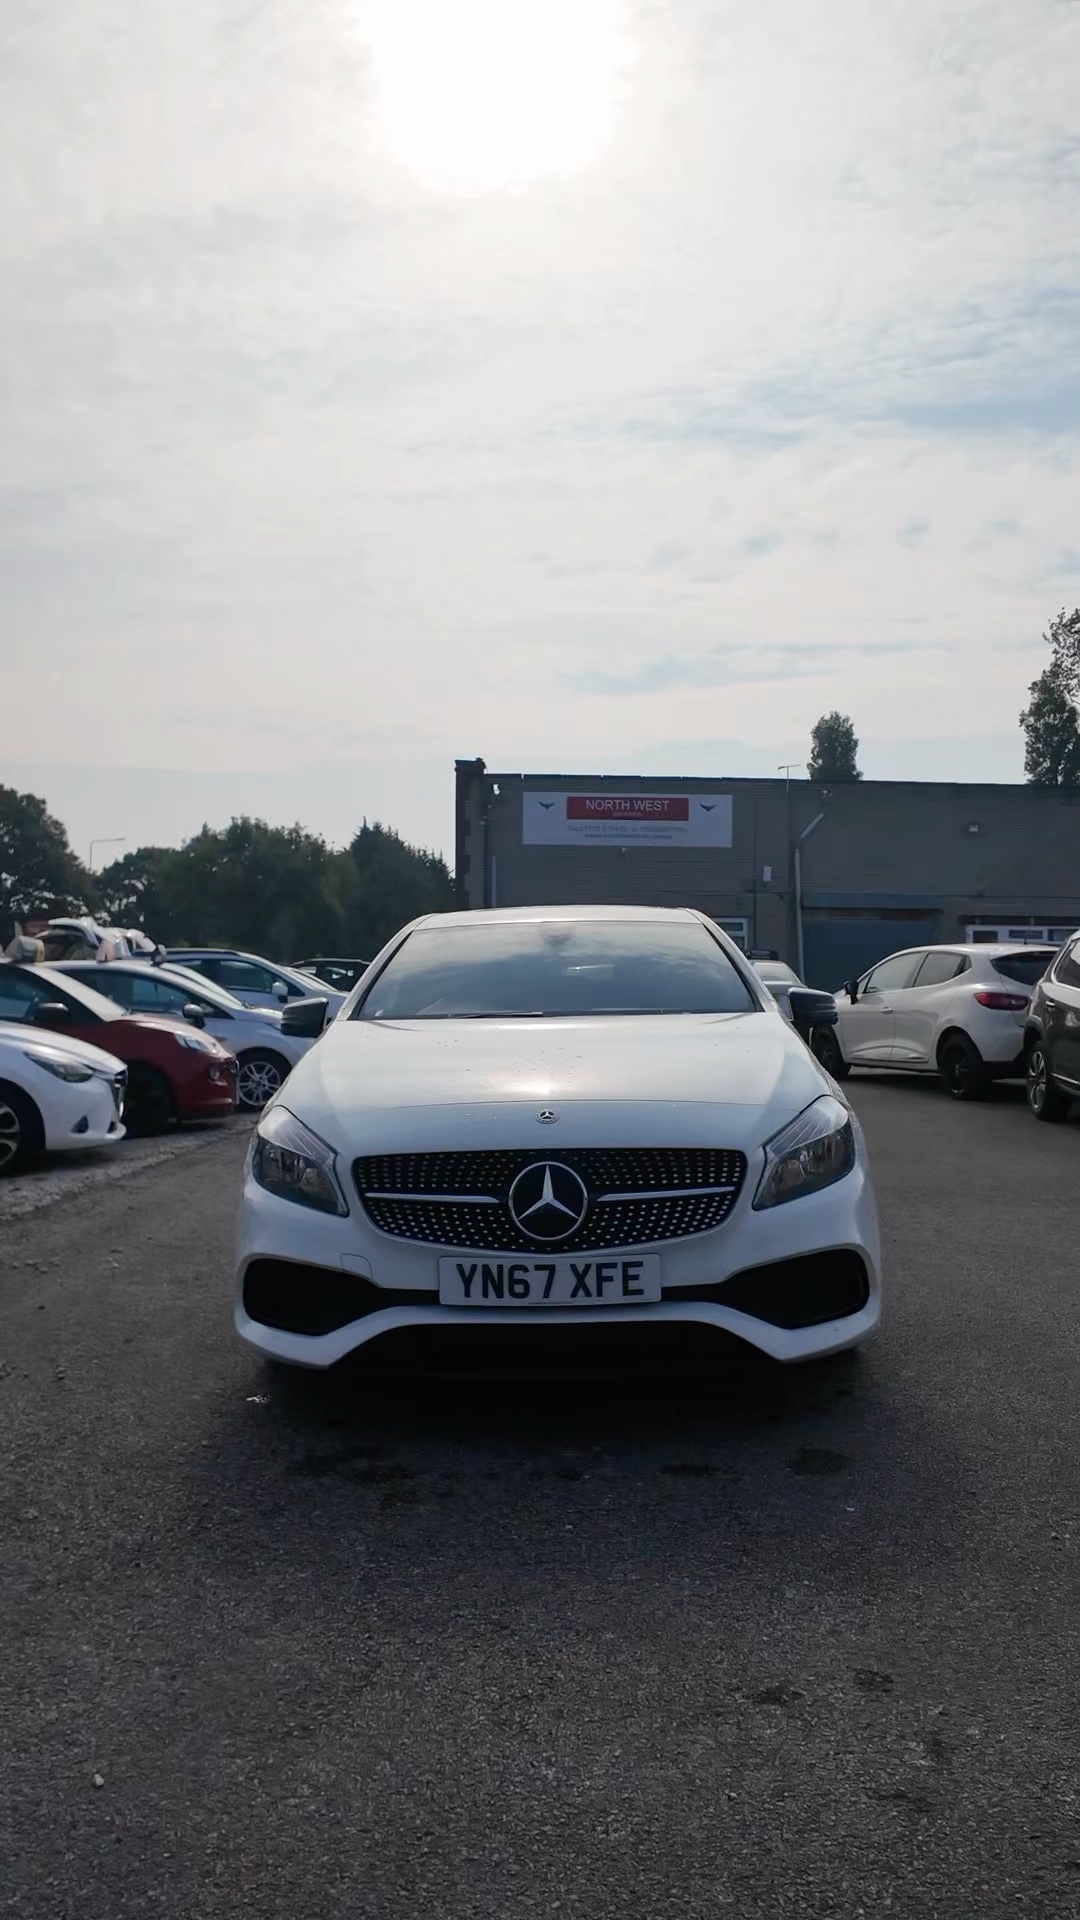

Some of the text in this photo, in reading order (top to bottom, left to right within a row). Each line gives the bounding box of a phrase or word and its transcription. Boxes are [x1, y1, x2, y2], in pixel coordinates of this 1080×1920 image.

[585, 799, 670, 811] NORTH WEST
[456, 1261, 644, 1299] YN67 XFE
